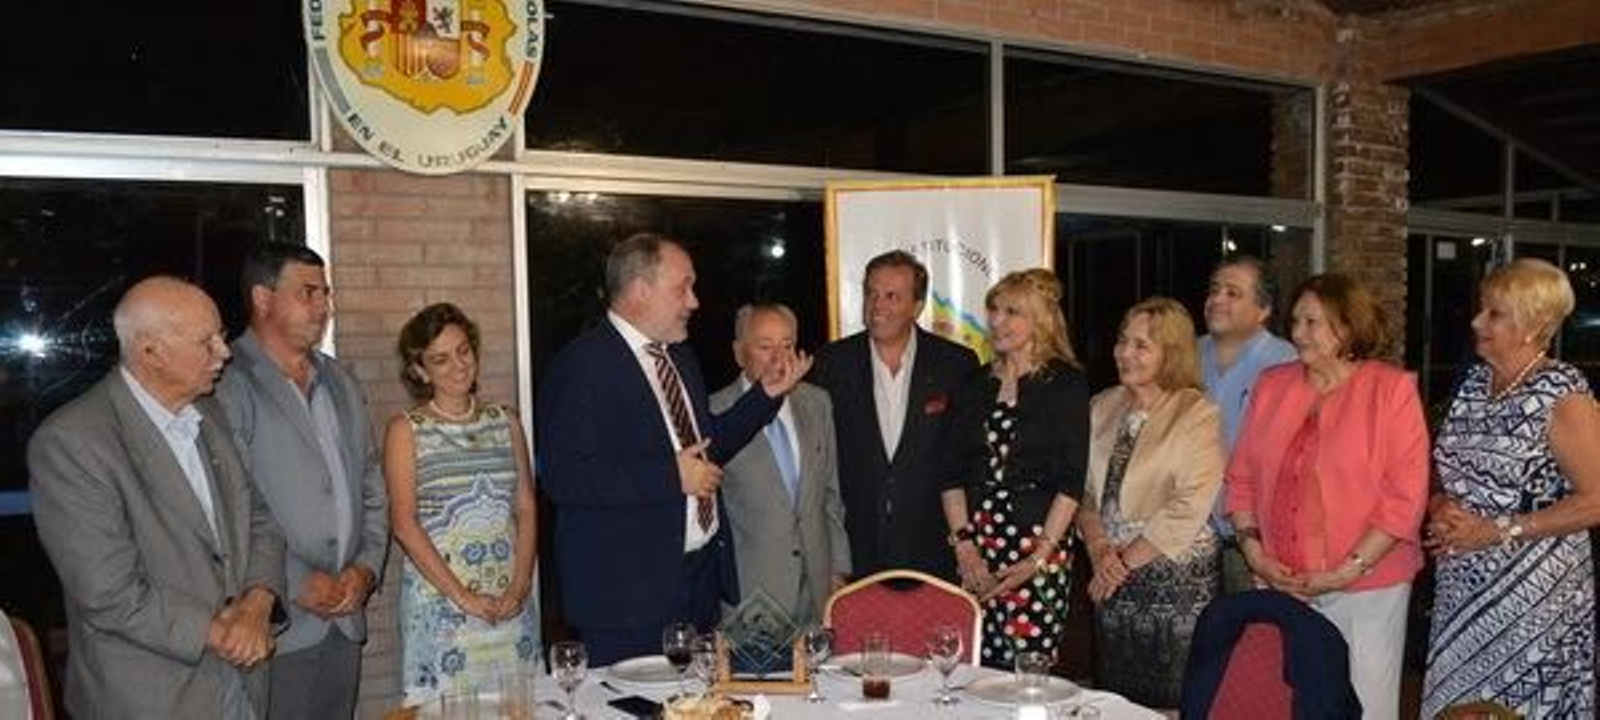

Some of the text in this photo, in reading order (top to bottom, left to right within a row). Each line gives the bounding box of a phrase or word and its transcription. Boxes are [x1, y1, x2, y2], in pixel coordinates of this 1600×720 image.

[347, 113, 508, 167] EN EL URUGUAY
